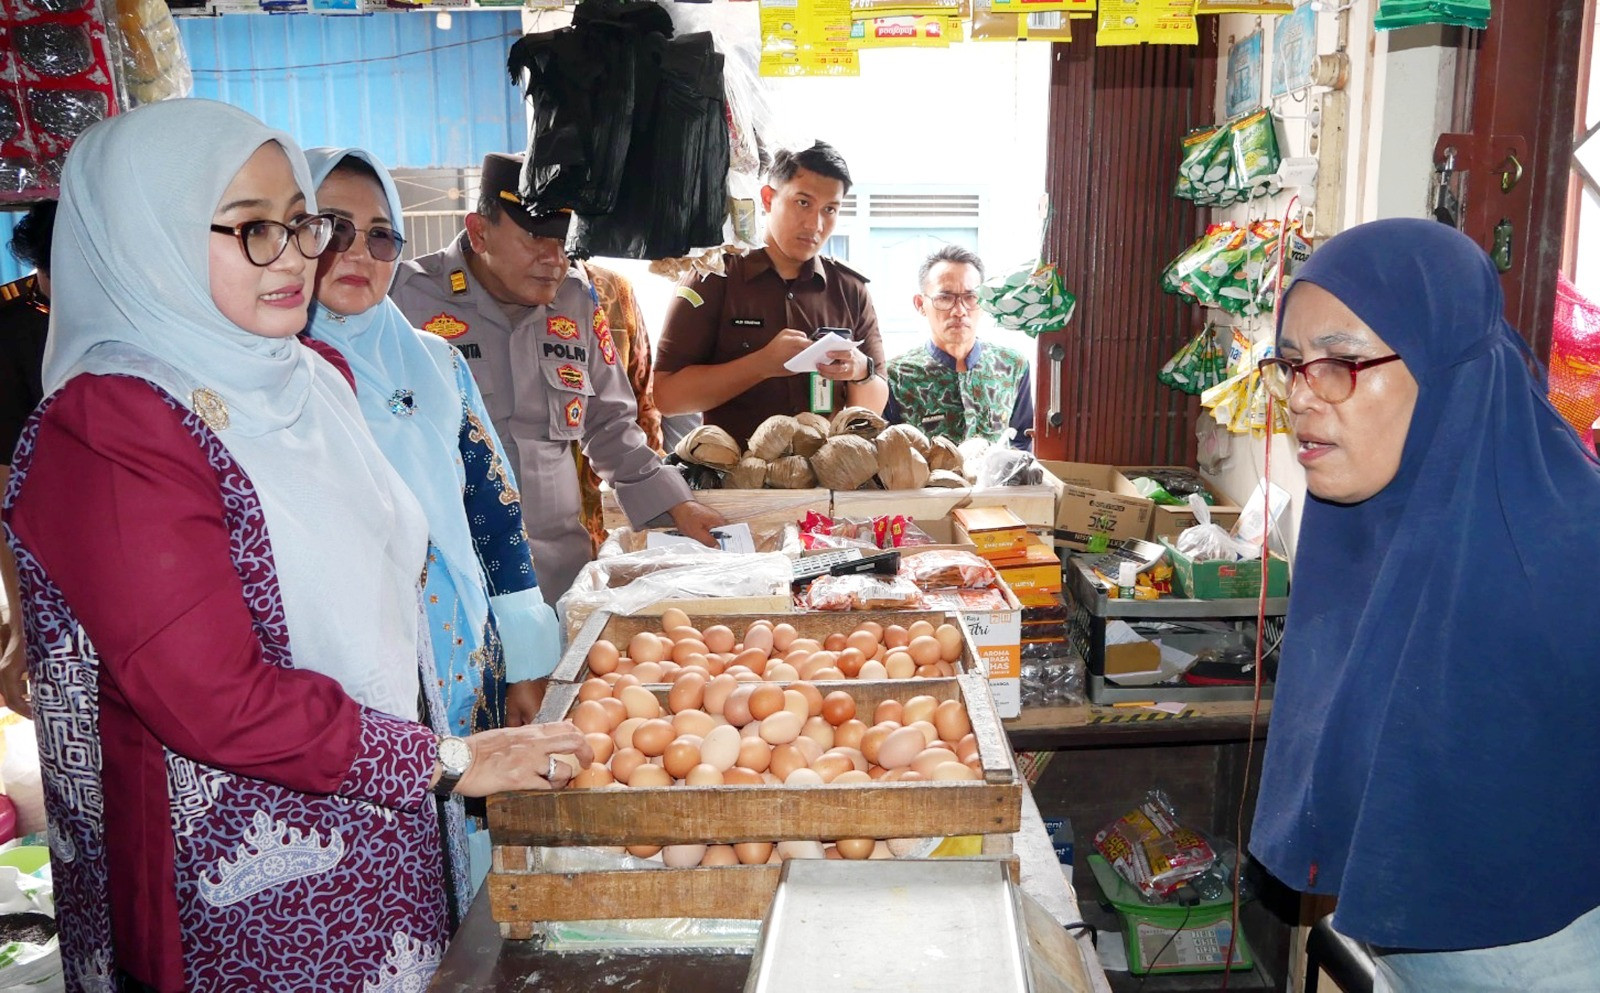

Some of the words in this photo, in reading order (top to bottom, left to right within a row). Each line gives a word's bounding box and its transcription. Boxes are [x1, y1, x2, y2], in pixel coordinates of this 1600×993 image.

[878, 26, 914, 36] Indofood
[543, 343, 586, 362] POLRI
[1088, 515, 1117, 532] ZINC
